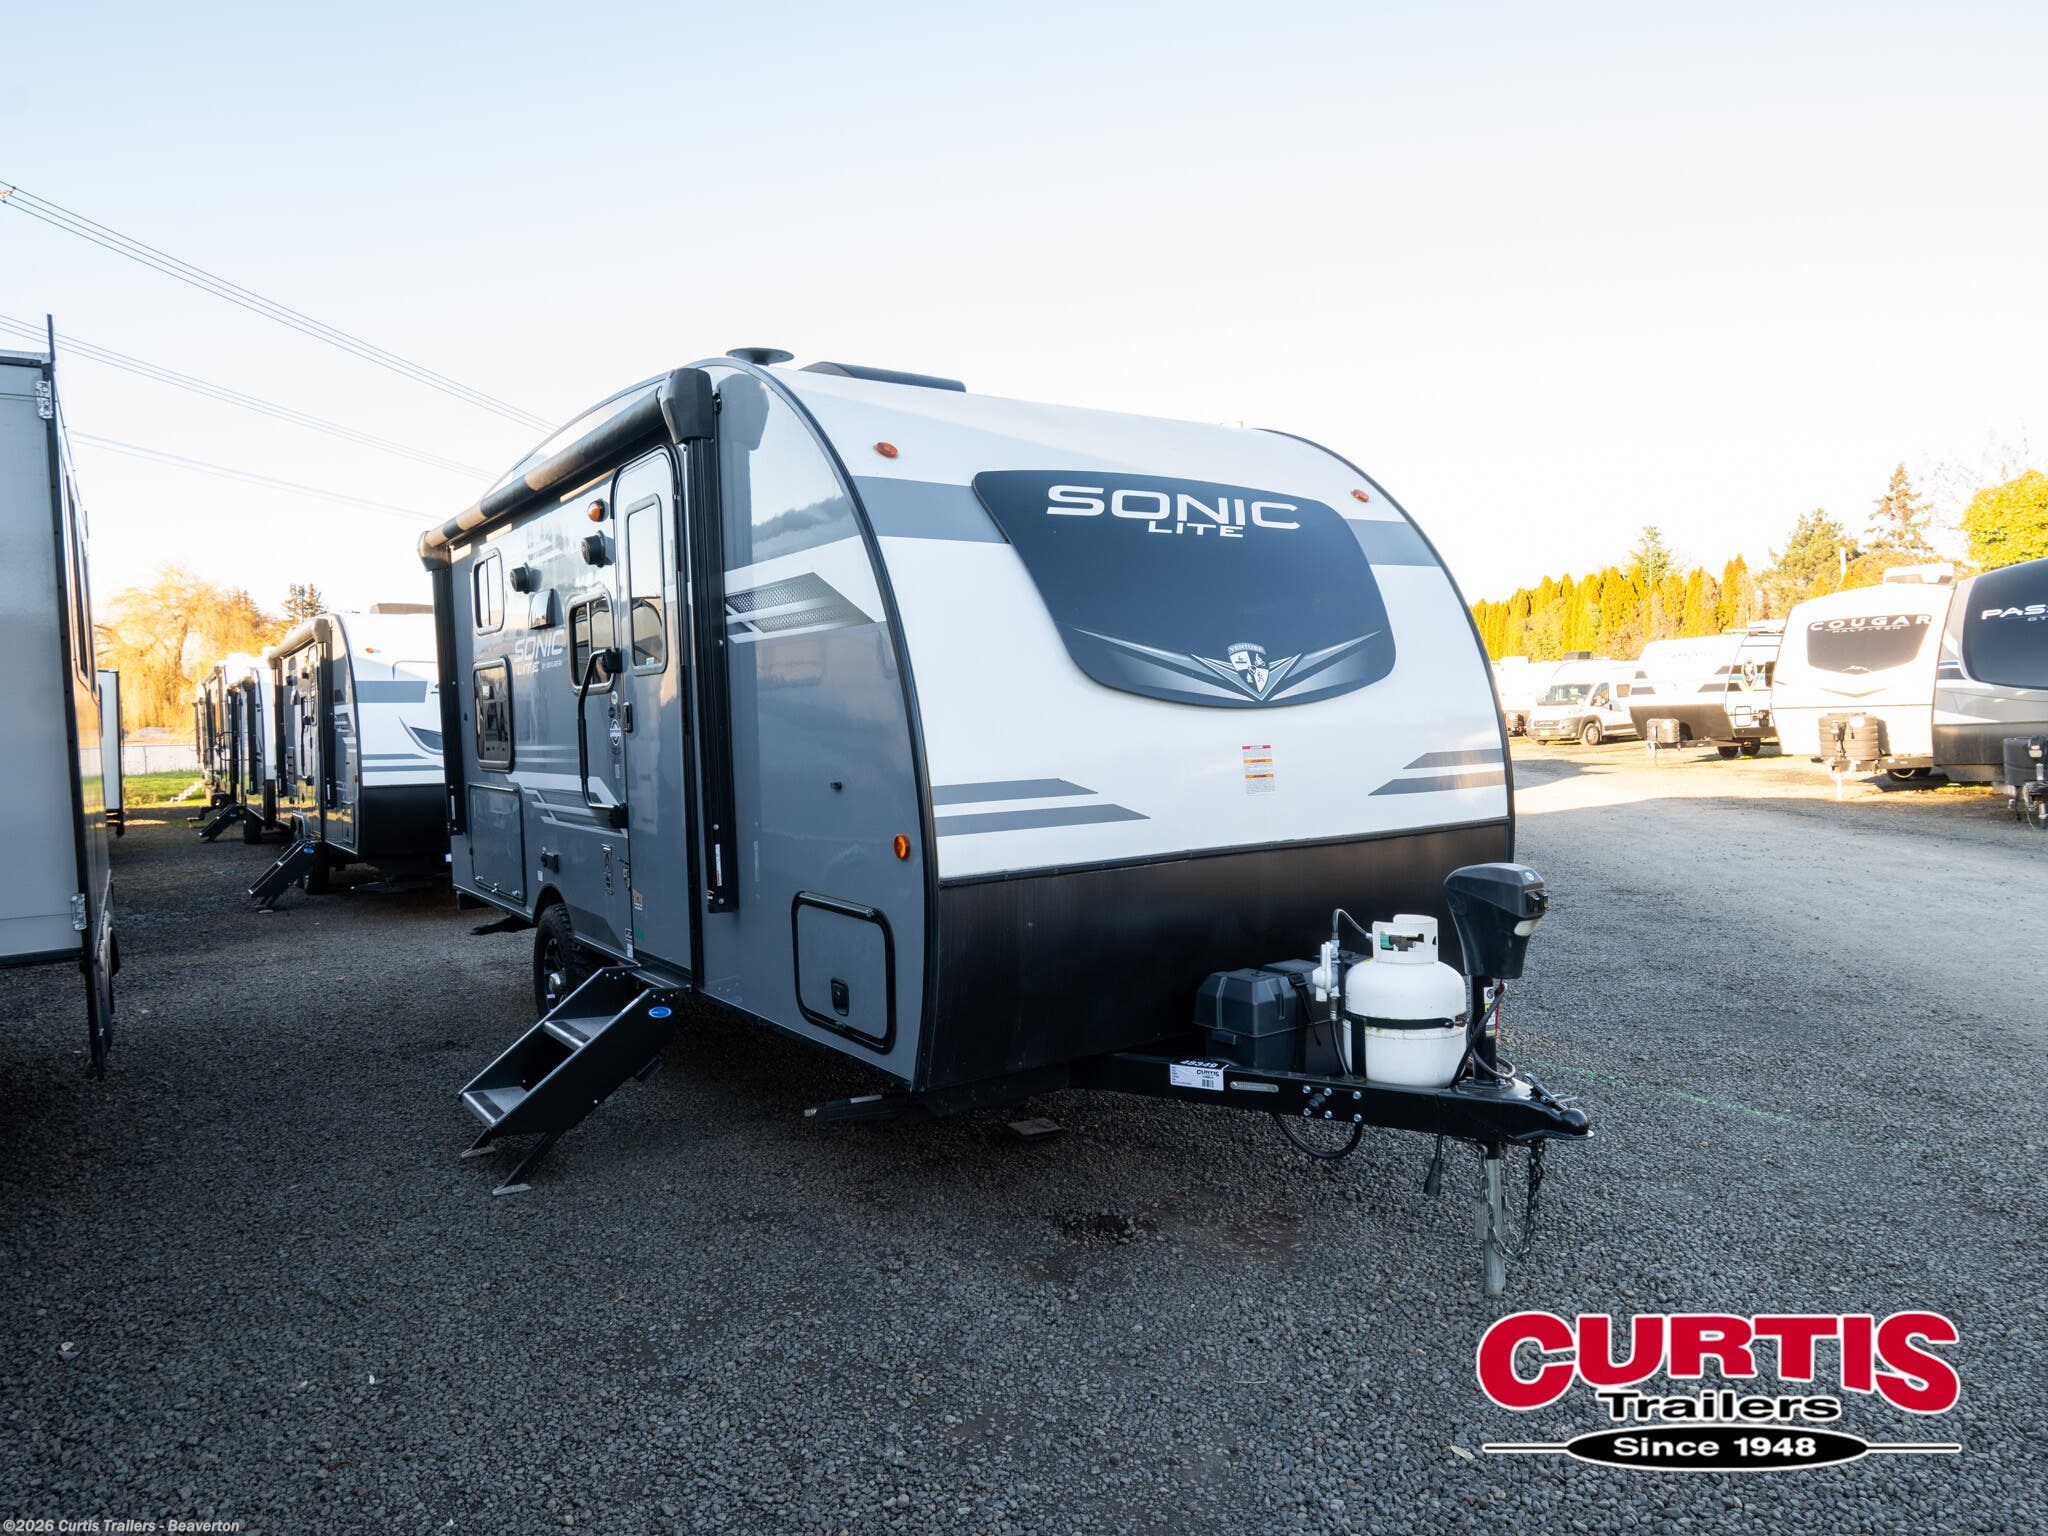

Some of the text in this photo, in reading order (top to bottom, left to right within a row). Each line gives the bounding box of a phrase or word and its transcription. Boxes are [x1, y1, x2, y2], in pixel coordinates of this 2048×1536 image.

[1046, 484, 1301, 530] SONIC
[1148, 520, 1244, 538] LITE
[1981, 604, 2048, 620] PAS
[1809, 615, 1931, 631] COUGAR
[514, 629, 565, 662] SONIC
